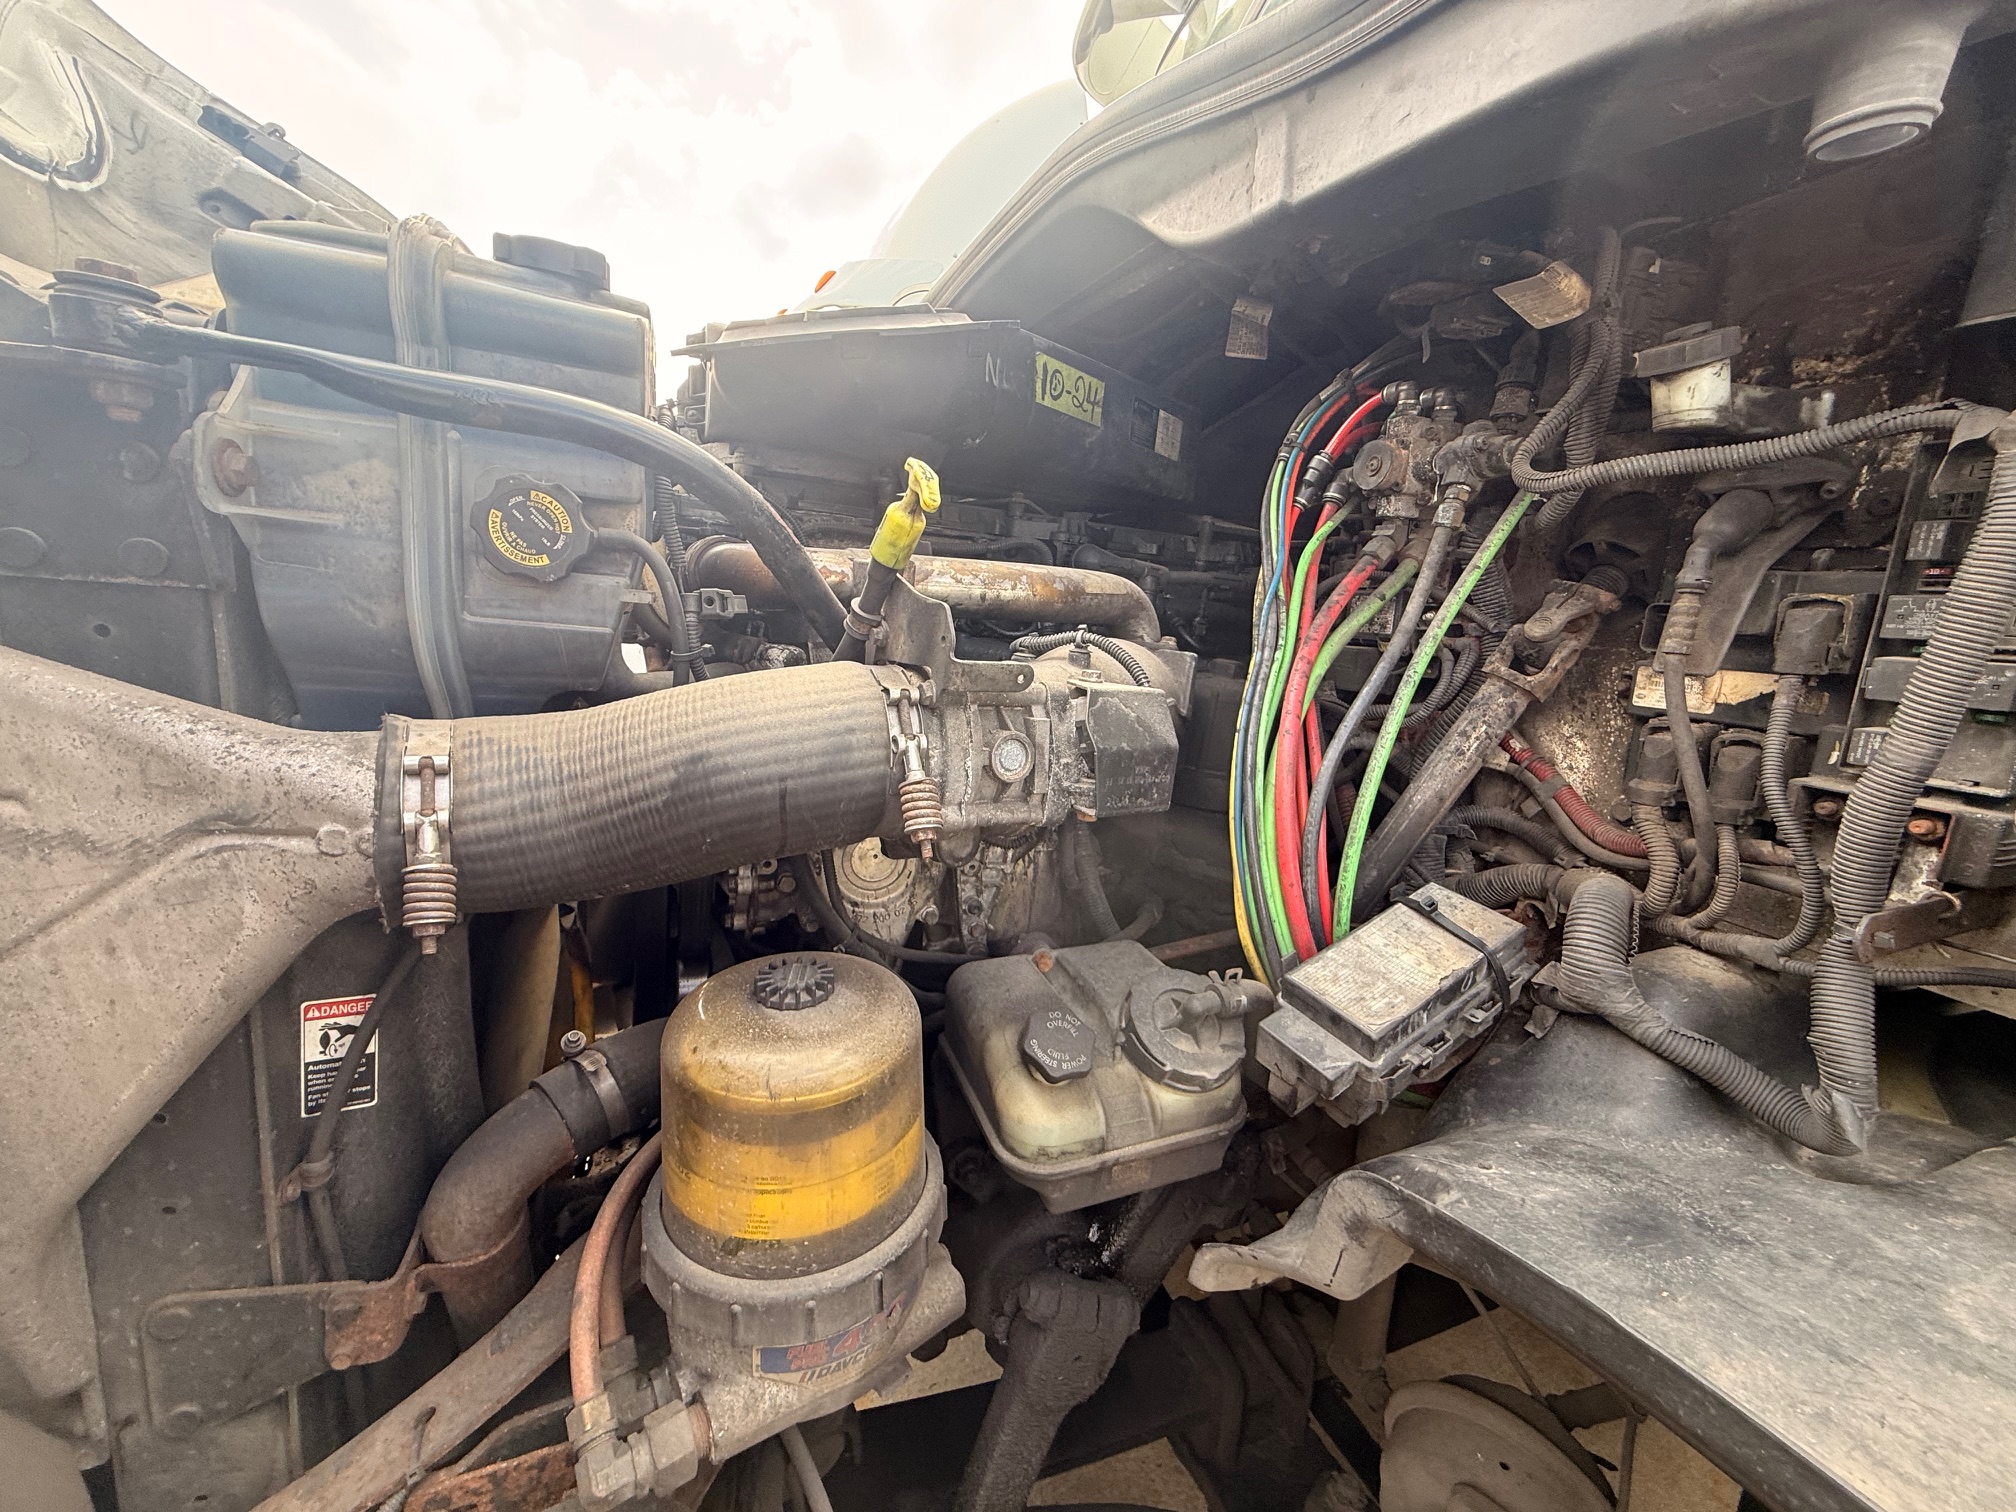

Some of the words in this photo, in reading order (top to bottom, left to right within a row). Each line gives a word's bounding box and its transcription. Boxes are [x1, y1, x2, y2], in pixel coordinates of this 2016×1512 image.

[1041, 361, 1101, 422] 10-24
[526, 501, 546, 511] NEVER
[545, 509, 559, 523] OPEN
[541, 497, 570, 532] CAUTION
[530, 515, 546, 530] SYSTEM
[490, 519, 545, 564] AVERTISSEMENT
[501, 521, 513, 543] OUVRIR
[516, 545, 537, 554] CHAUD
[510, 531, 518, 541] NE
[516, 538, 528, 548] PAS
[1048, 1011, 1062, 1019] DO
[1065, 1013, 1082, 1027] NOT
[1046, 1019, 1079, 1038] OVERFILL
[1030, 1038, 1058, 1068] STEERING
[1047, 1048, 1070, 1060] FLUID
[1061, 1053, 1087, 1070] POWER
[308, 1072, 326, 1080] Keep
[308, 1078, 326, 1086] when
[308, 1092, 321, 1100] Fan
[352, 1085, 371, 1093] stops
